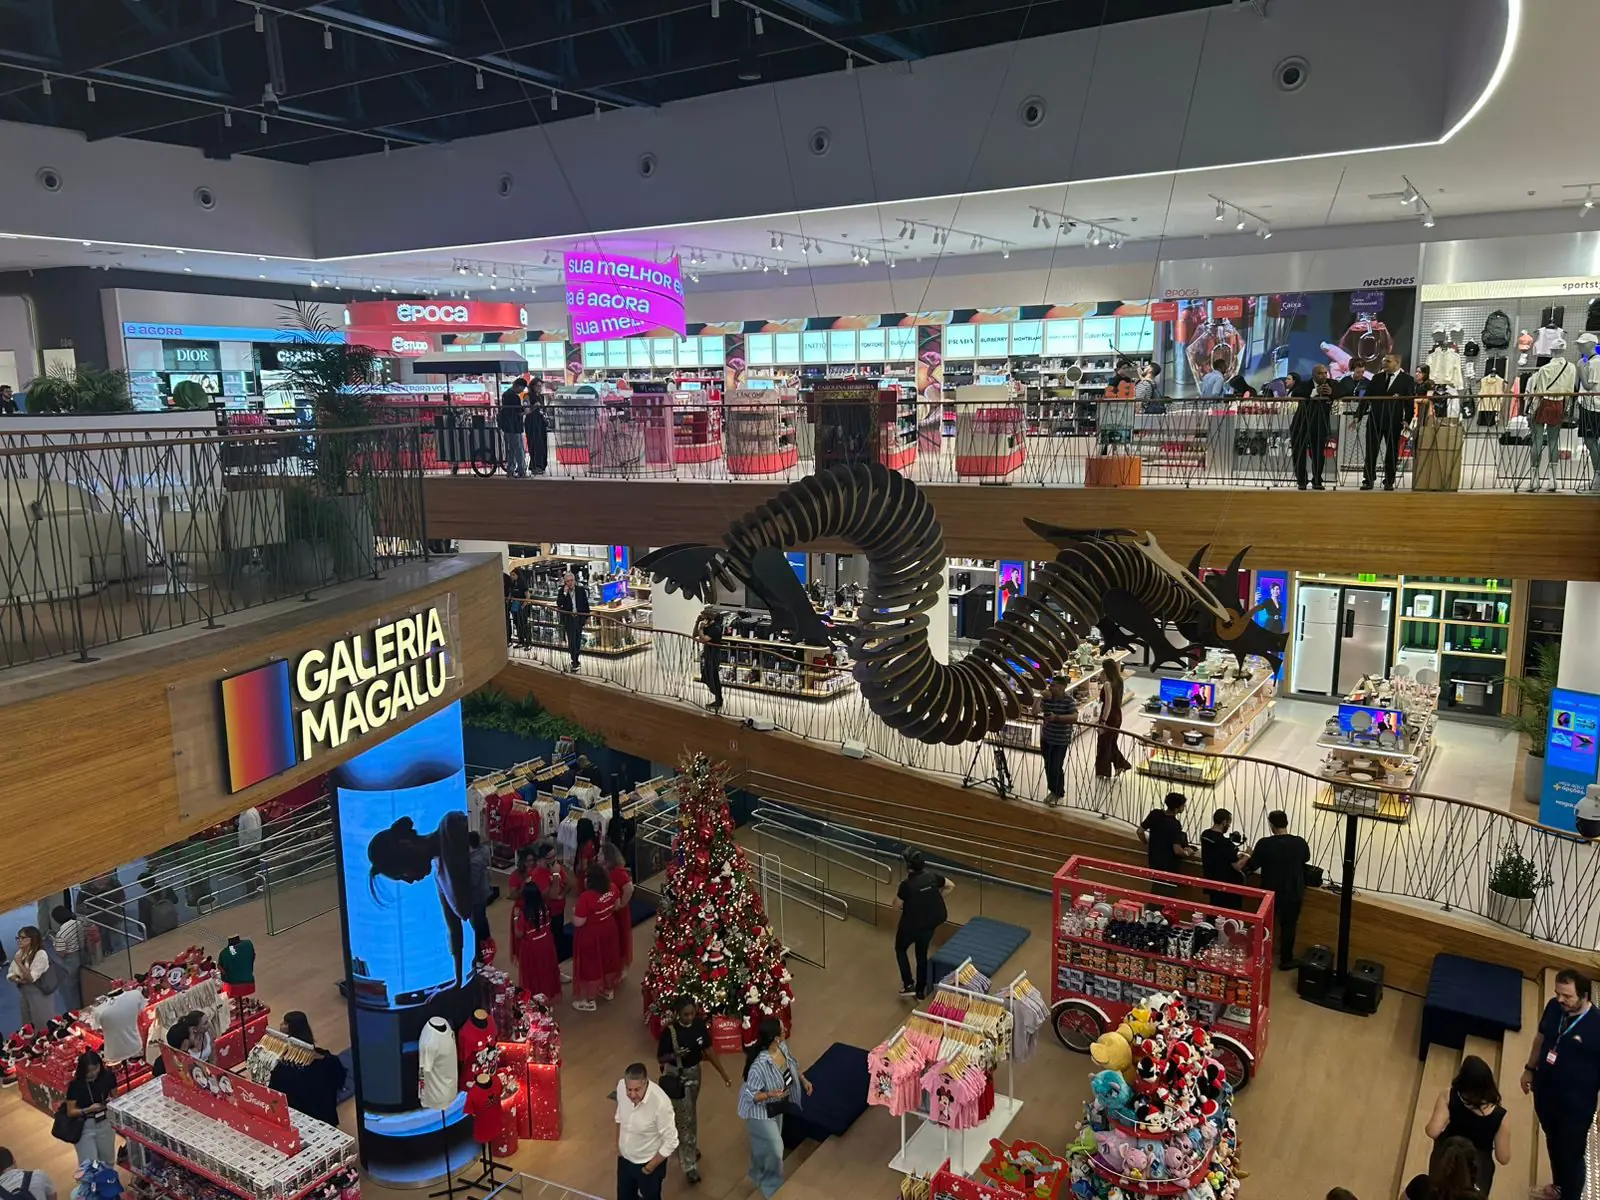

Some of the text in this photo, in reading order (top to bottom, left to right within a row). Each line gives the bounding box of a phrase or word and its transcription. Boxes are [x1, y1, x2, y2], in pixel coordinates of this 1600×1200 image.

[568, 259, 594, 274] sua
[576, 288, 585, 306] é
[575, 321, 600, 336] sua
[947, 338, 975, 346] PRADA
[176, 349, 210, 362] DIOR
[296, 607, 446, 702] GALERIA
[300, 651, 447, 761] MAGALU
[718, 1020, 737, 1028] NATAL
[236, 1085, 271, 1114] Disney
[1002, 1181, 1026, 1198] Disney
